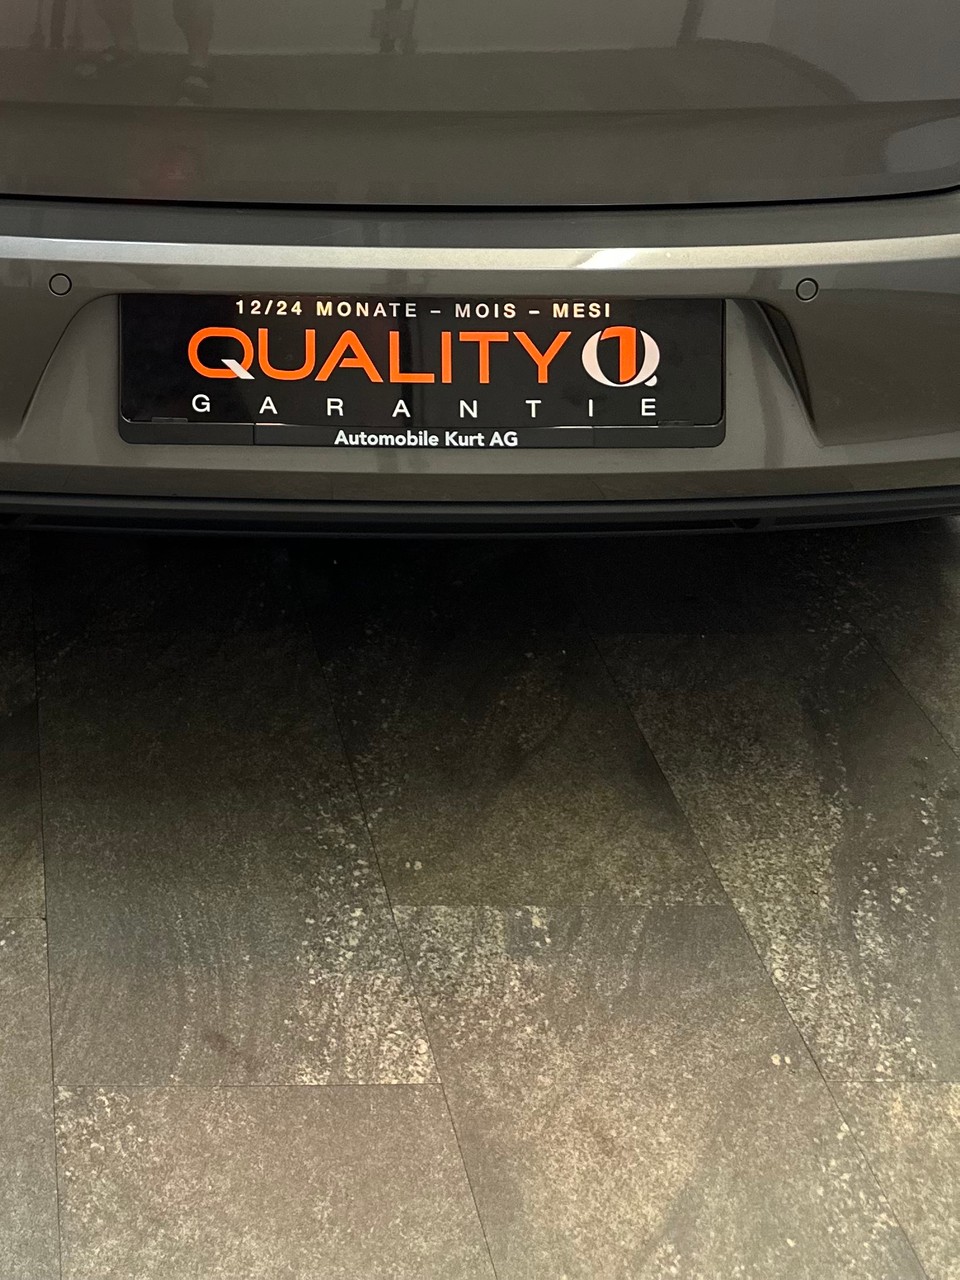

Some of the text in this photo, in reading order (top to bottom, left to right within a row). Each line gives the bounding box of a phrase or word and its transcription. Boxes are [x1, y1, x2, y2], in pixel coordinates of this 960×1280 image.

[235, 299, 303, 317] 12/24
[316, 300, 418, 318] MONATE
[455, 303, 517, 319] MOIS
[552, 302, 611, 319] MESI
[188, 326, 572, 384] QUALITY
[191, 393, 656, 419] GARANTIE
[333, 429, 519, 447] Automobile Kurt AG
